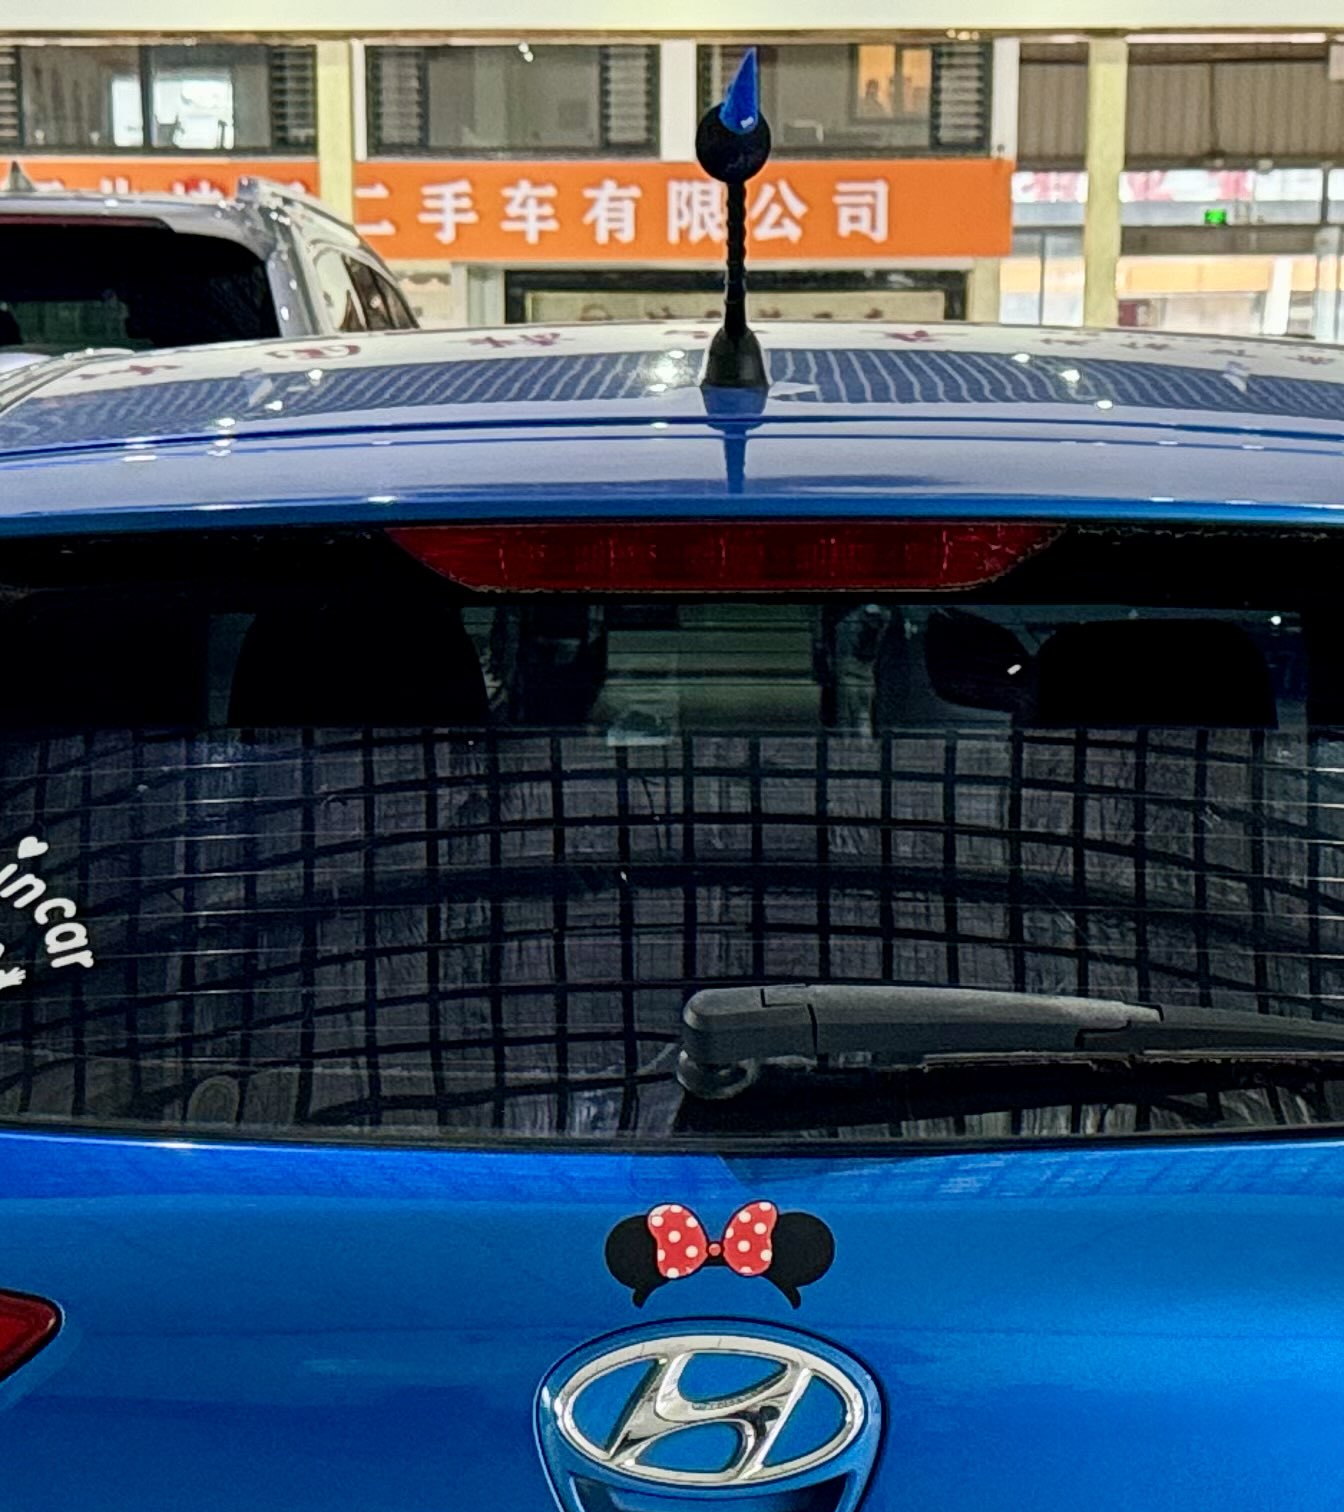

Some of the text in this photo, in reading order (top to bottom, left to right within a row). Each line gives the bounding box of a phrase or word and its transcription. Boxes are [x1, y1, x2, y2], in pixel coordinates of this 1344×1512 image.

[355, 177, 891, 246] 二手车有限公司
[34, 897, 94, 968] car
